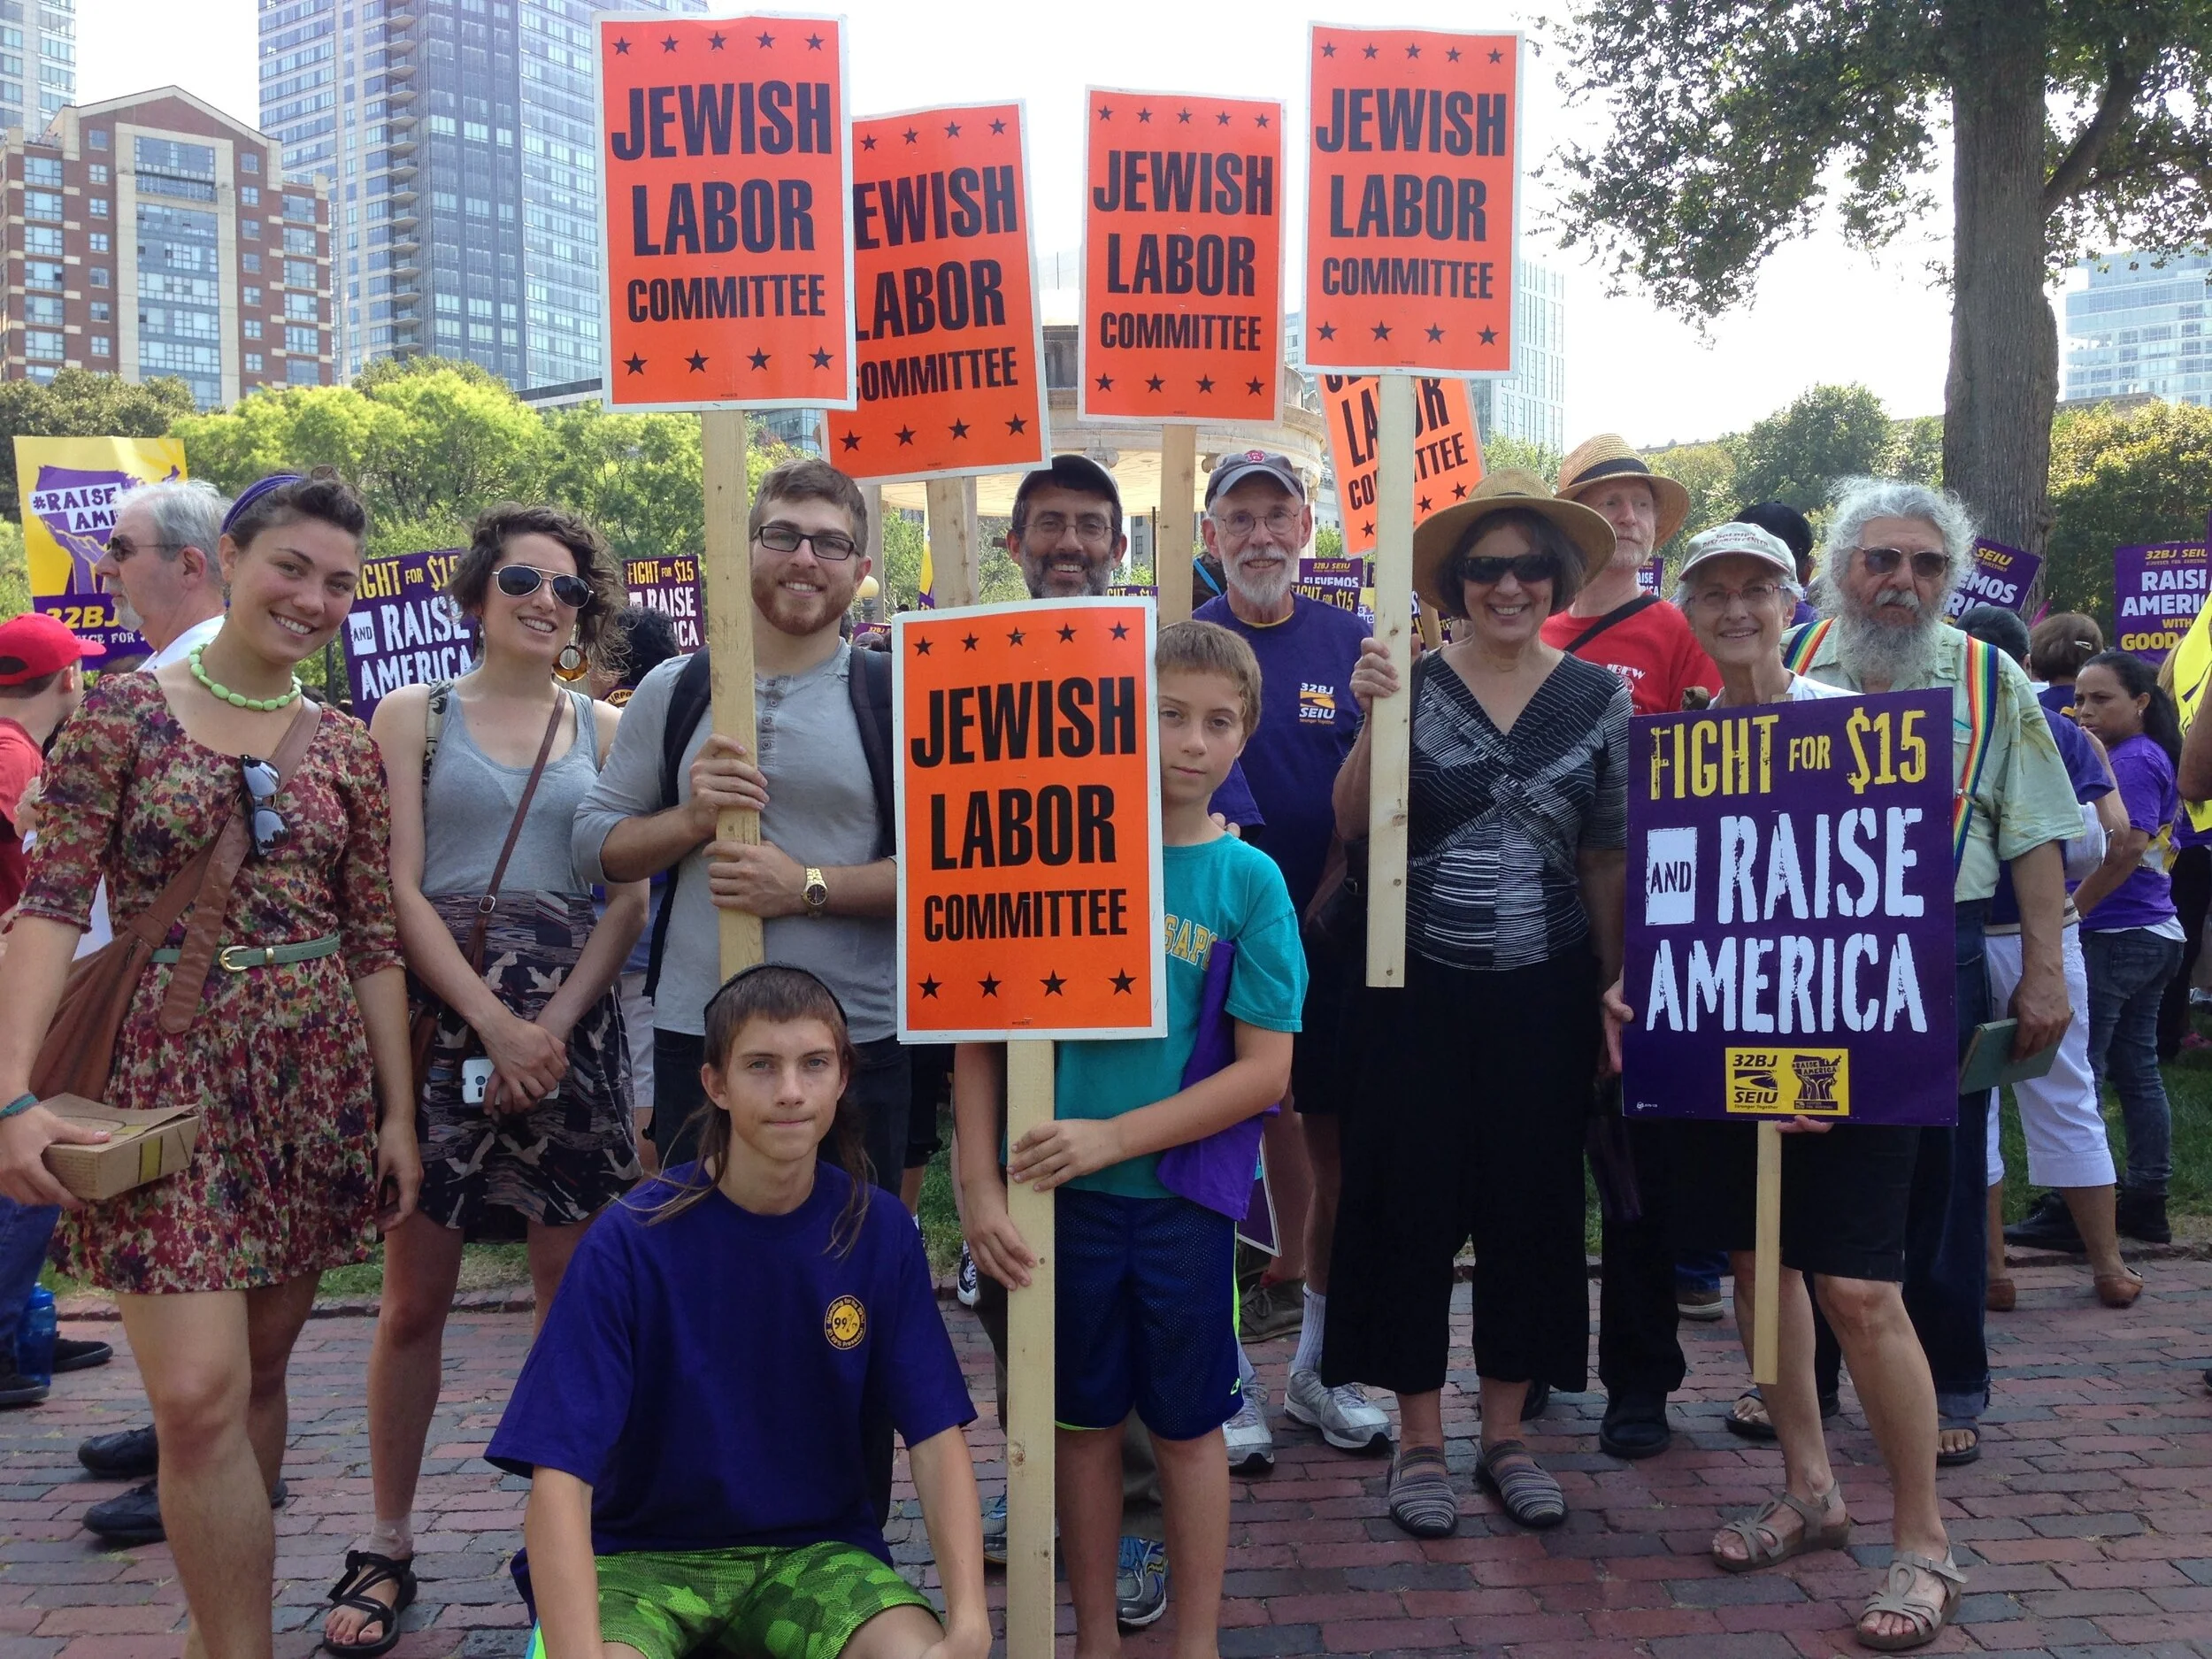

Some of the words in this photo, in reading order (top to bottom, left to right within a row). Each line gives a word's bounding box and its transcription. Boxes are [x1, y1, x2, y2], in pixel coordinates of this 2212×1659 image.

[611, 81, 832, 161] JEWISH
[1316, 88, 1507, 157] JEWISH
[1094, 150, 1273, 216] JEWISH
[632, 179, 815, 257] LABOR
[855, 165, 1018, 251] EWISH
[1330, 174, 1487, 242] LABOR
[1107, 234, 1256, 296] LABOR
[1322, 257, 1494, 299] COMMITTEE
[627, 274, 826, 323] COMMITTEE
[1100, 312, 1262, 351] COMMITTEE
[856, 347, 1018, 402] OMMITTEE
[33, 487, 117, 511] #RAISE
[627, 561, 659, 585] FIGHT
[674, 559, 694, 584] $15
[1976, 548, 2013, 565] SEIU
[2145, 549, 2177, 559] 32BJ
[355, 561, 402, 600] IGHT
[405, 567, 424, 585] FOR
[380, 595, 471, 651] RAISE
[2121, 593, 2206, 617] AMERI
[2162, 618, 2193, 628] WITH
[111, 632, 135, 644] FOR
[354, 626, 373, 641] AND
[2121, 632, 2179, 651] GOOD
[1300, 682, 1334, 695] 32BJ
[910, 676, 1137, 769] JEWISH
[1299, 707, 1336, 719] SEIU
[1650, 715, 1778, 800] FIGHT
[1789, 735, 1831, 772] FOR
[1846, 706, 1927, 795] $15
[930, 784, 1117, 871] LABOR
[1650, 858, 1692, 895] AND
[1717, 806, 1924, 925] RAISE
[924, 888, 1128, 942] COMMITTEE
[1646, 933, 1928, 1034] AMERICA
[1732, 1054, 1778, 1068] 32BJ
[1733, 1091, 1778, 1104] SEIU
